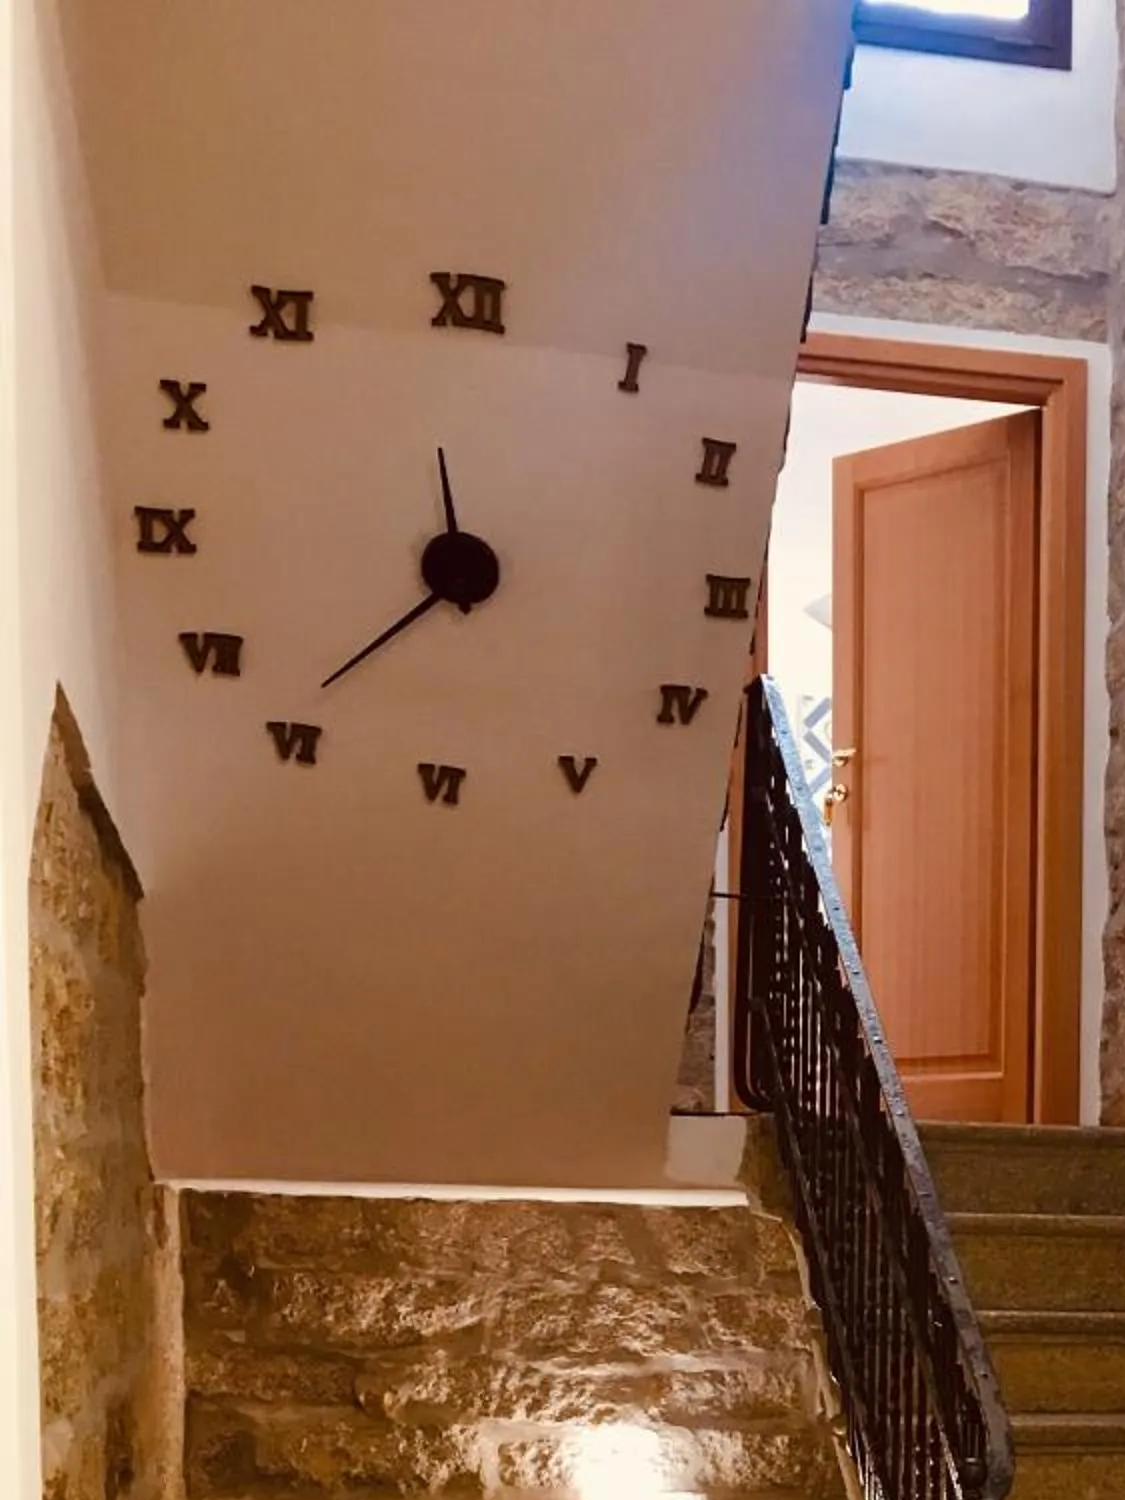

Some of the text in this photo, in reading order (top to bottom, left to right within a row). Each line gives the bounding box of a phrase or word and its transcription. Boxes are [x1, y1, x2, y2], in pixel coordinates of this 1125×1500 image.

[249, 285, 314, 342] XI
[430, 272, 506, 335] XII
[618, 343, 647, 393] I
[160, 380, 209, 433] X
[695, 438, 736, 488] II
[134, 506, 197, 555] IX
[704, 574, 750, 619] III
[657, 685, 708, 725] IV
[418, 763, 466, 806] VI
[558, 756, 597, 794] V
